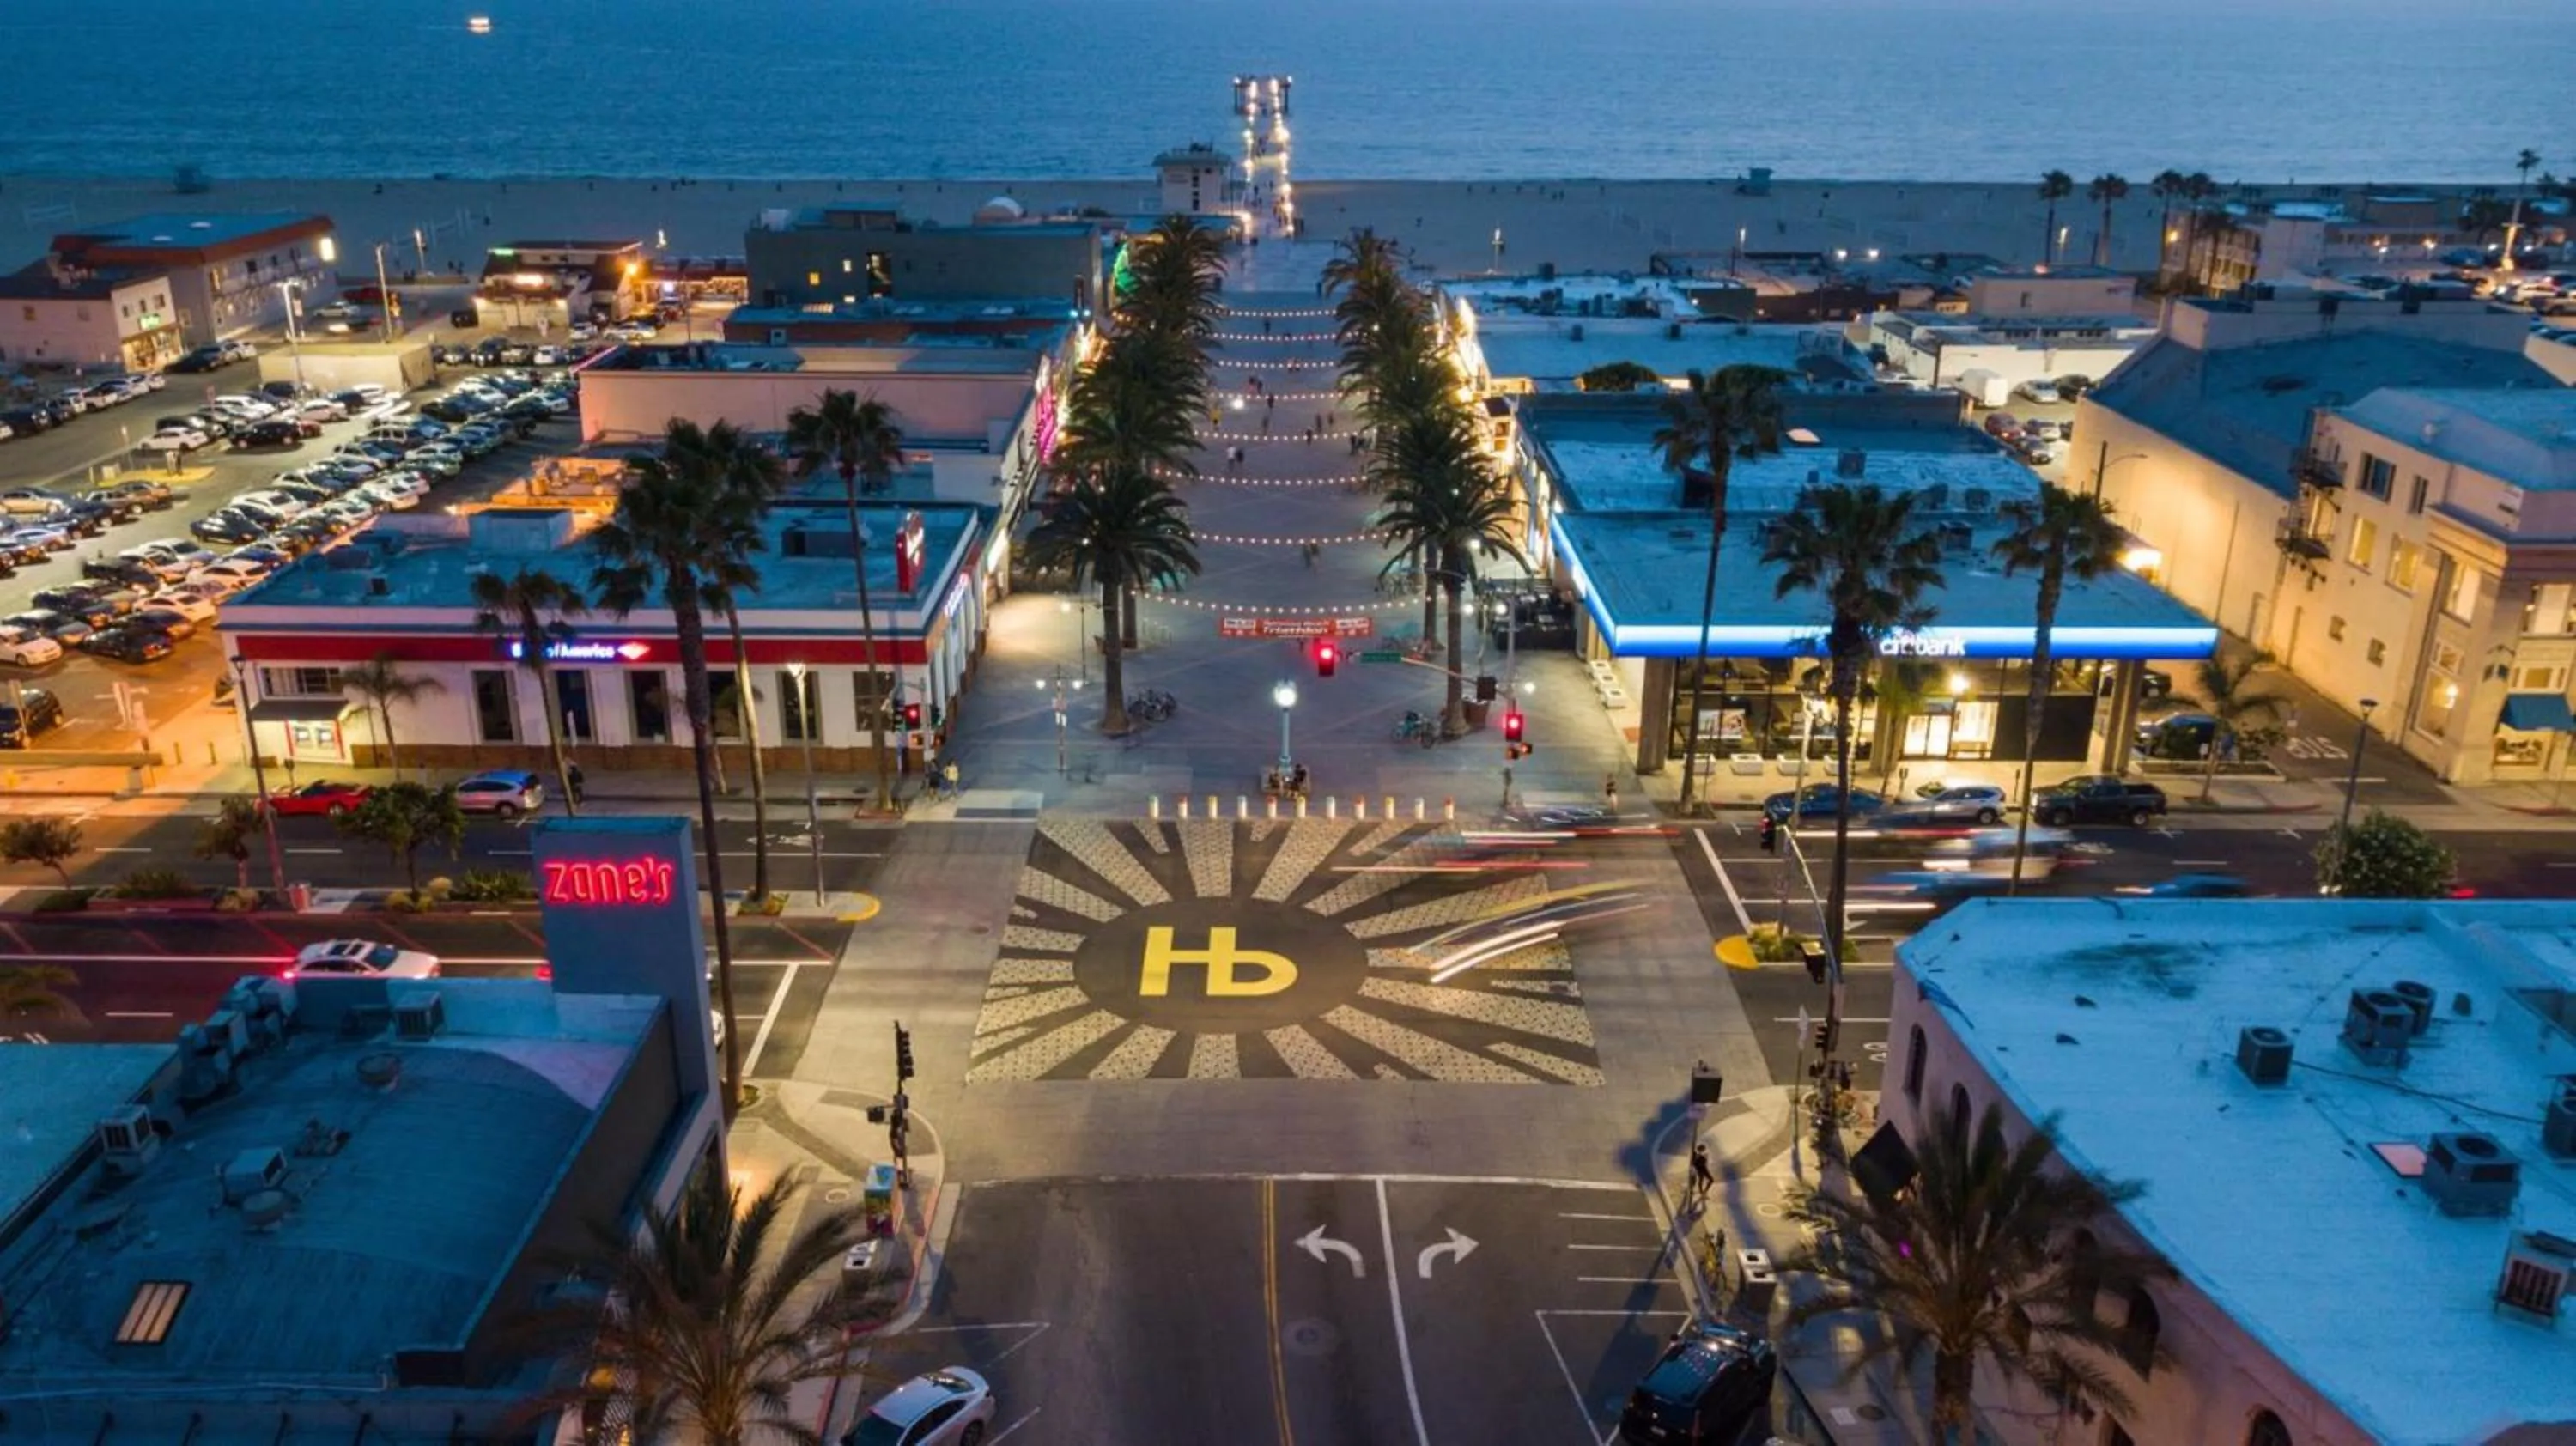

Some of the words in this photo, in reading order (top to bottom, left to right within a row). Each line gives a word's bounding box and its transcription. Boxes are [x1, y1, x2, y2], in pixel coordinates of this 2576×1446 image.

[561, 642, 615, 659] America
[1880, 635, 1965, 656] citbank
[544, 855, 674, 905] zane's
[1139, 927, 1298, 996] Hb
